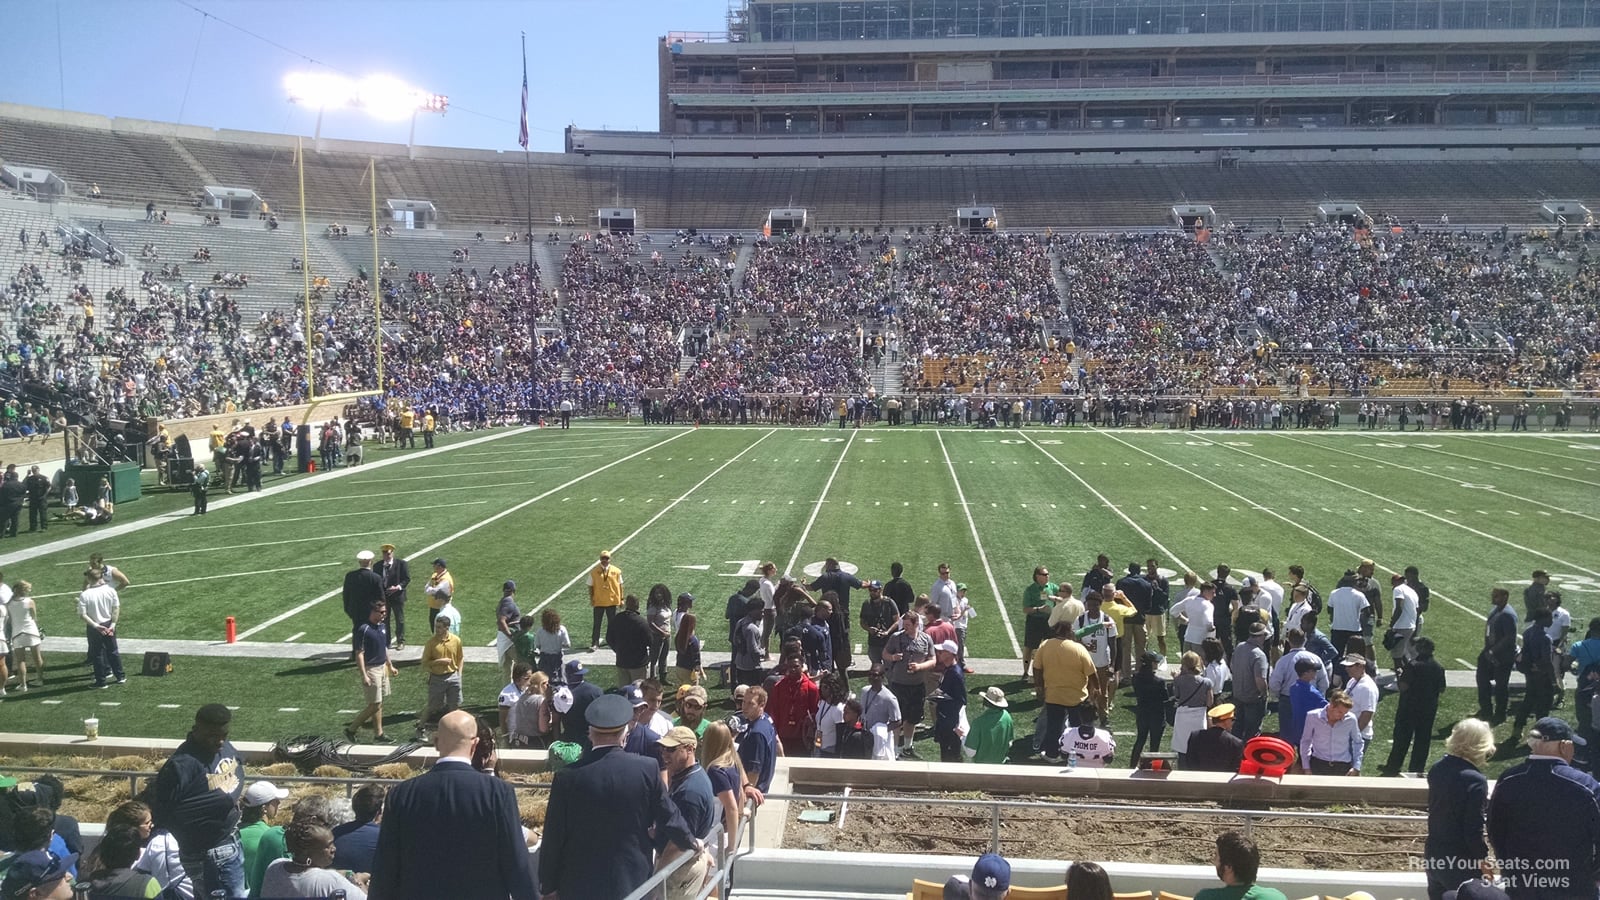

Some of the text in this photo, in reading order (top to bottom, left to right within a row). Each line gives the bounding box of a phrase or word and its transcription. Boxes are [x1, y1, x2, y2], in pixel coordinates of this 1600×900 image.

[149, 655, 161, 671] G
[1073, 741, 1098, 751] MOM OF
